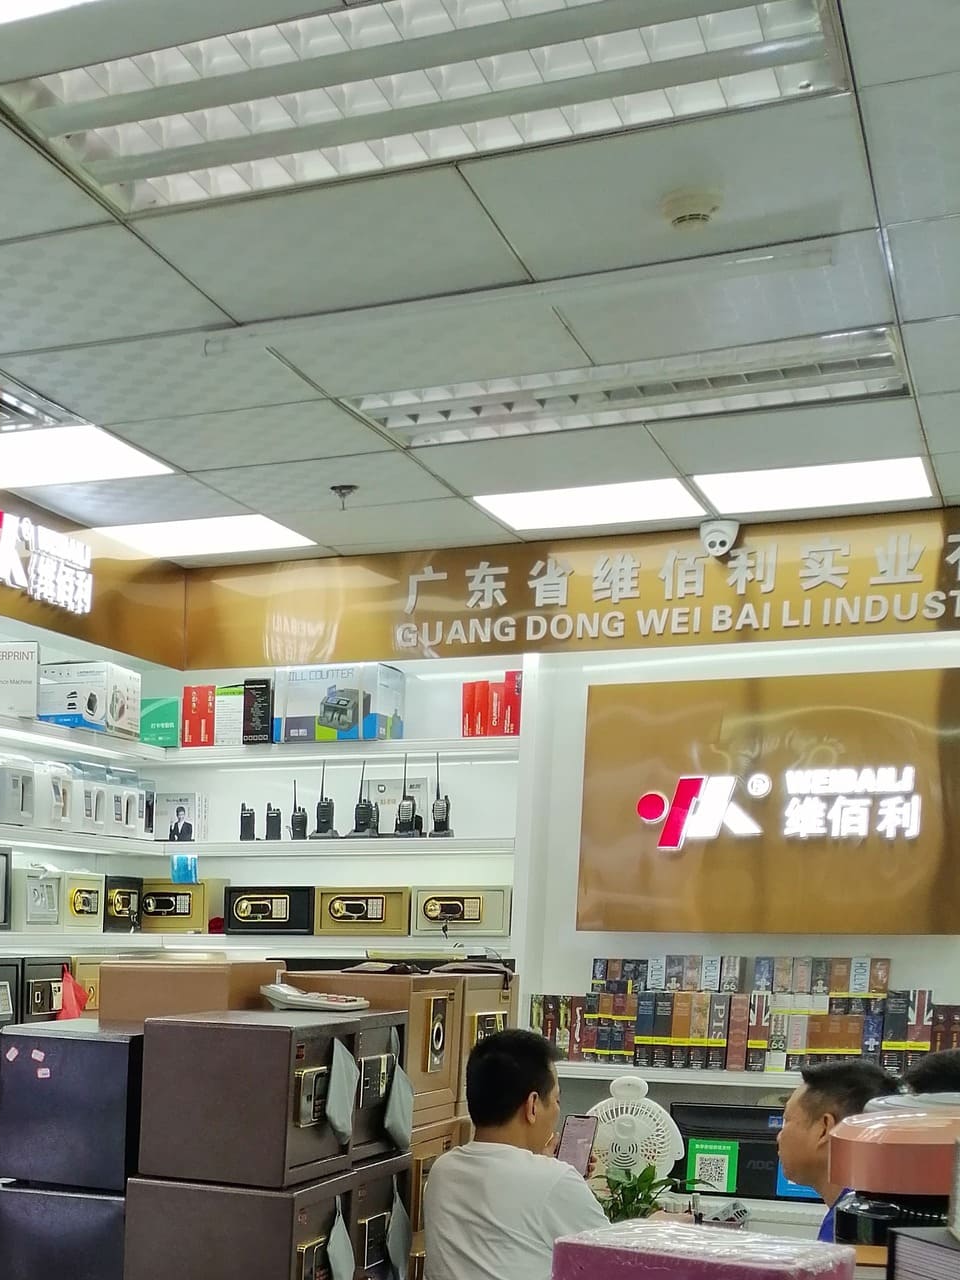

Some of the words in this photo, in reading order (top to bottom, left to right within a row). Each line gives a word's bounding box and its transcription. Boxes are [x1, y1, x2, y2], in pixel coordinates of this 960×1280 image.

[396, 616, 516, 648] GUANG
[526, 610, 624, 641] DONG
[636, 606, 701, 636] WEI
[711, 602, 770, 632] BAI
[782, 598, 811, 628] LI
[785, 766, 915, 794] WEIBAILI
[783, 795, 922, 838] 维佰利
[771, 1040, 785, 1049] 66
